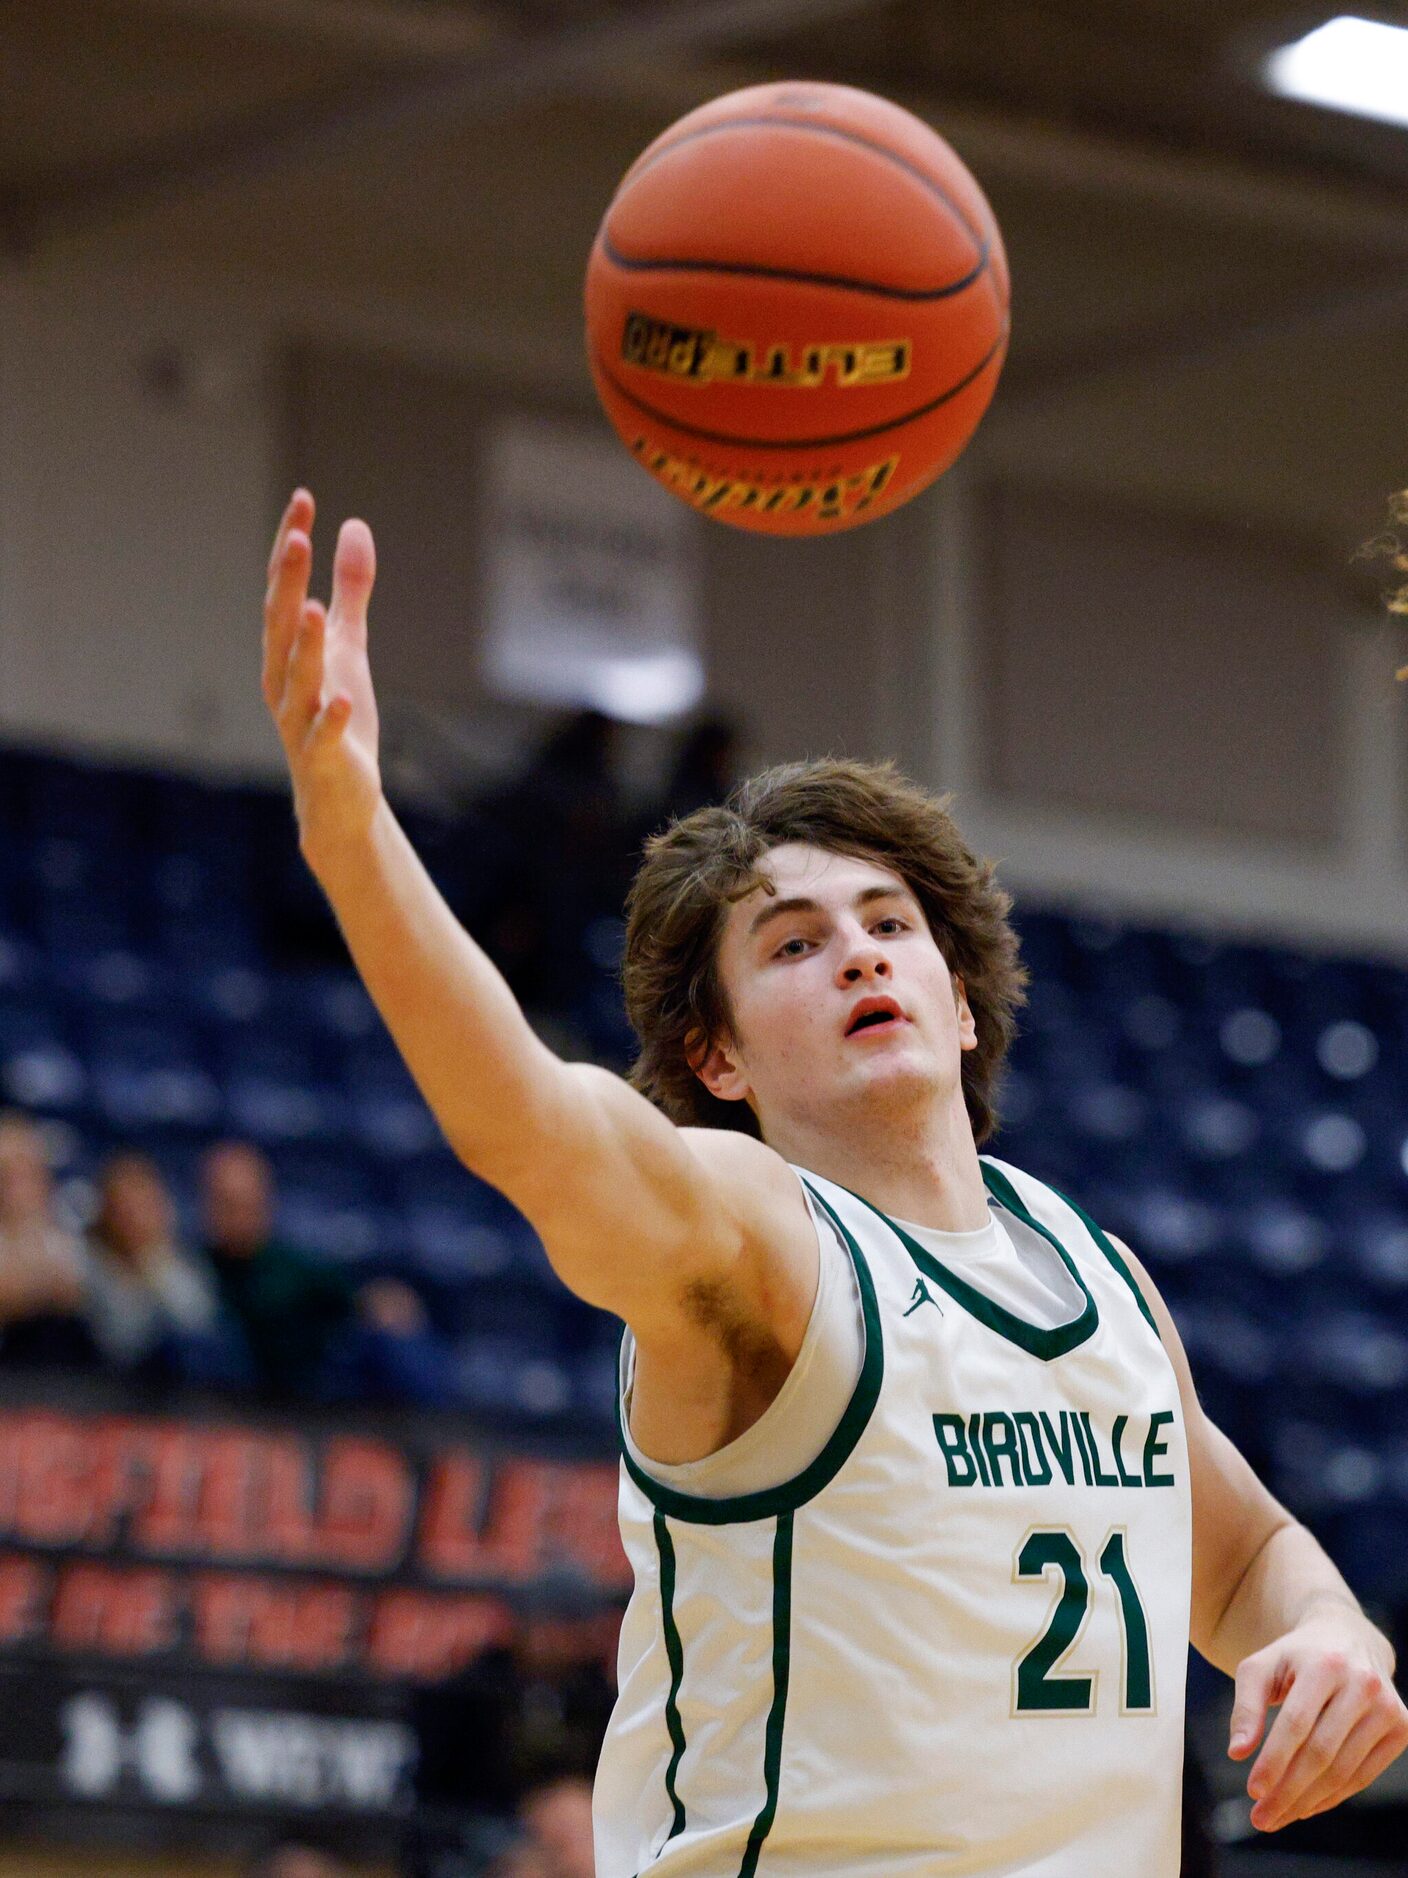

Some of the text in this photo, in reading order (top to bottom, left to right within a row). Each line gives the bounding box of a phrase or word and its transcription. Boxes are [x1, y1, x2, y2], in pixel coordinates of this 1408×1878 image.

[708, 336, 911, 387] ELITE
[932, 1410, 1175, 1487] BIRDVILLE
[1009, 1523, 1157, 1718] 21
